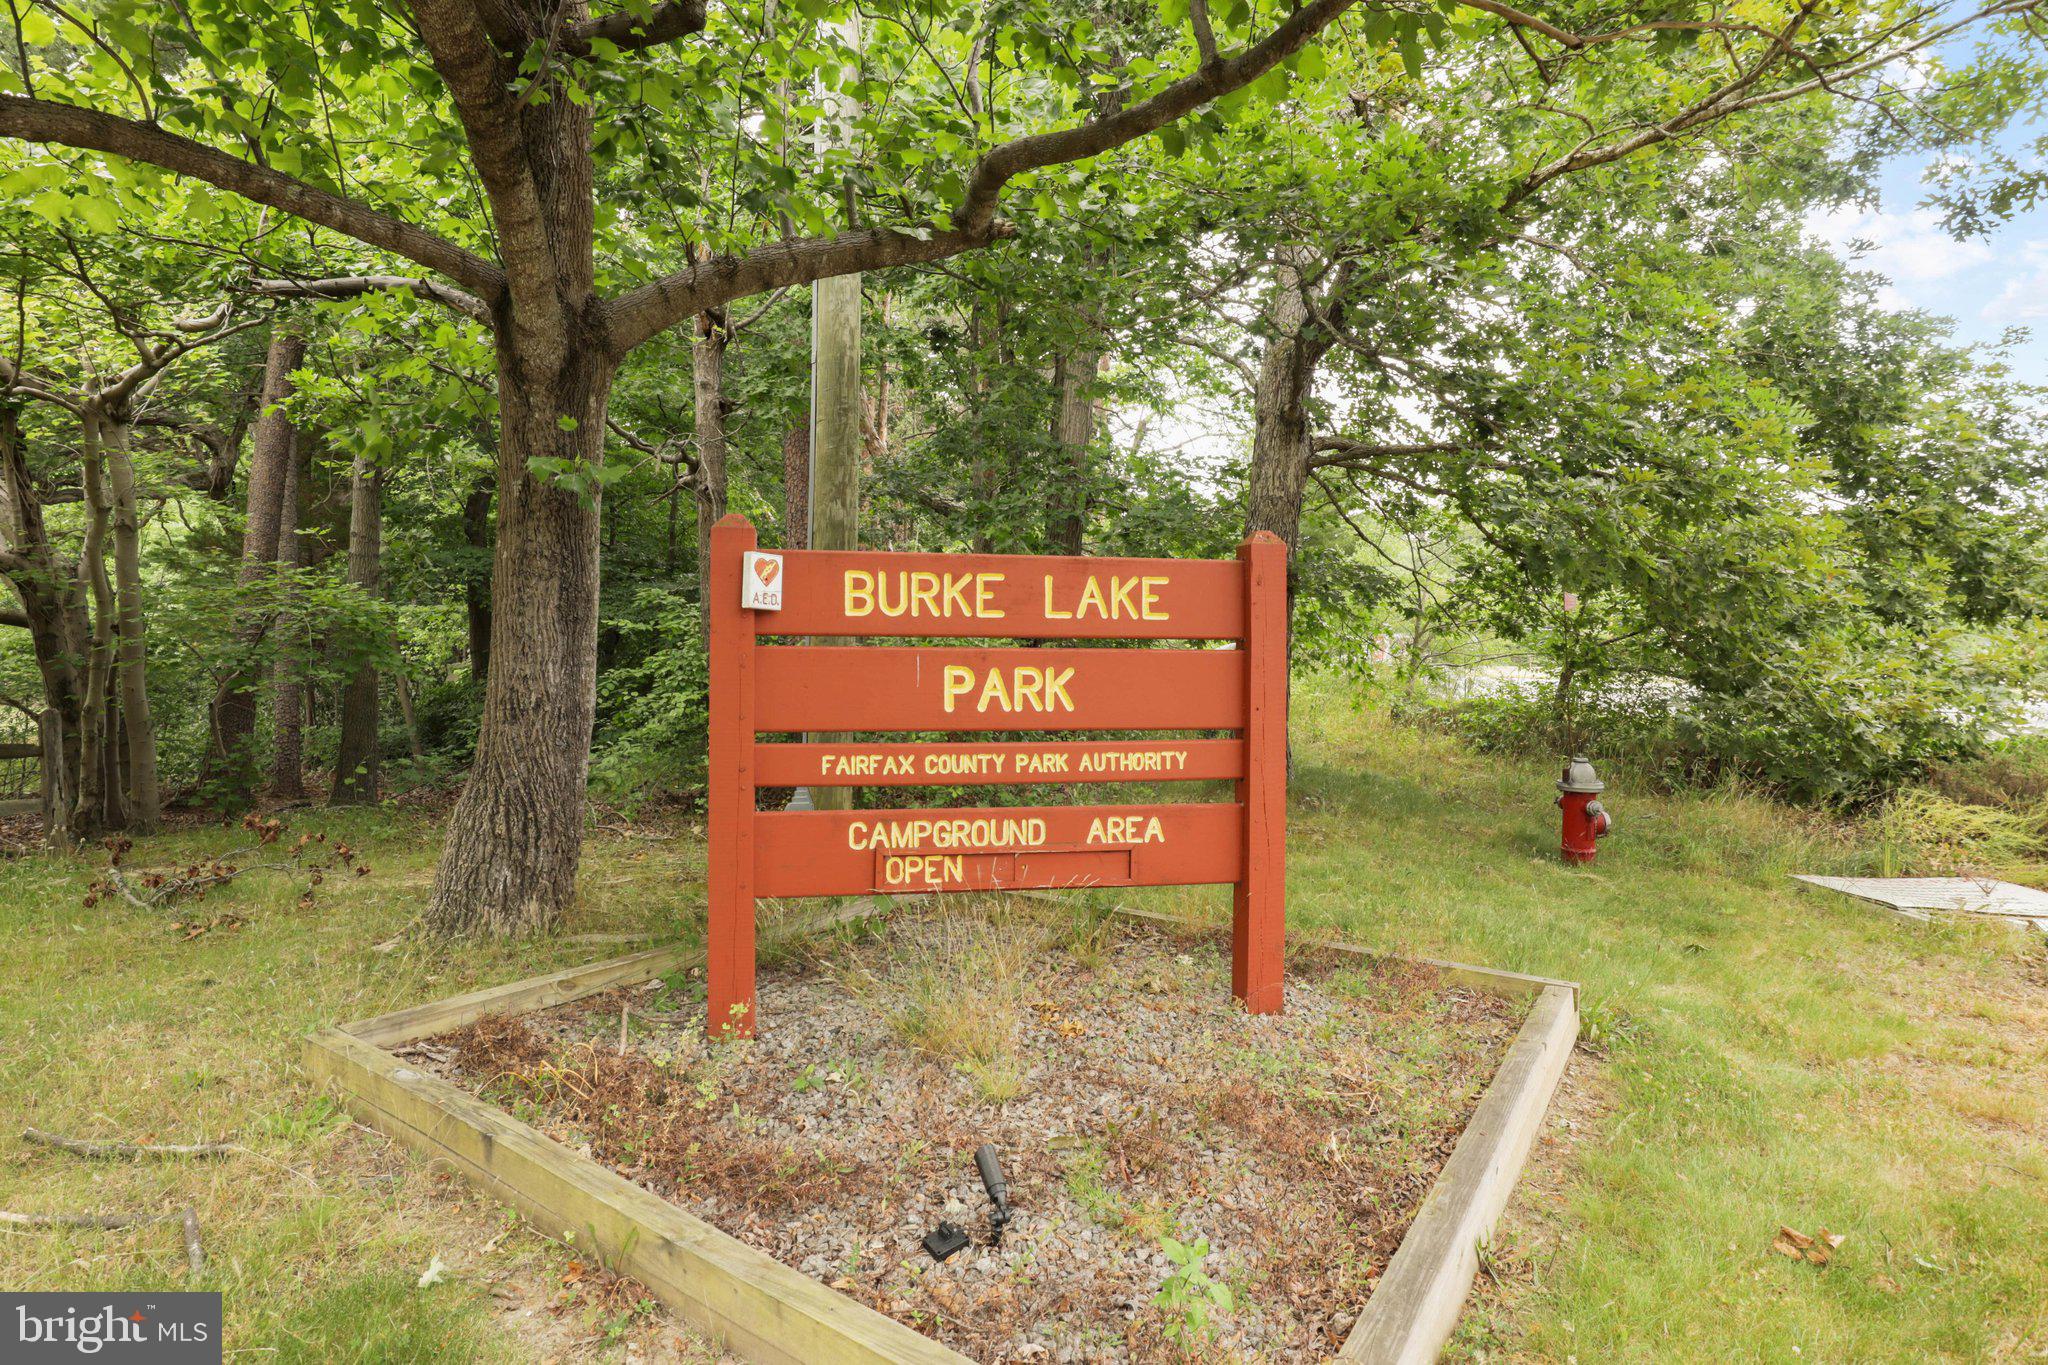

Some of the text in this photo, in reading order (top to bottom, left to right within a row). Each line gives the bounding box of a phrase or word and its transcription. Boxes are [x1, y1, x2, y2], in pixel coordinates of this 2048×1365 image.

[843, 568, 1170, 621] BURKE LAKE
[943, 664, 1076, 713] PARK
[821, 750, 1188, 776] FAIRFAX COUNTY PARK AUTHORITY
[848, 815, 1166, 851] CAMPGROUND AREA
[885, 854, 964, 885] OPEN
